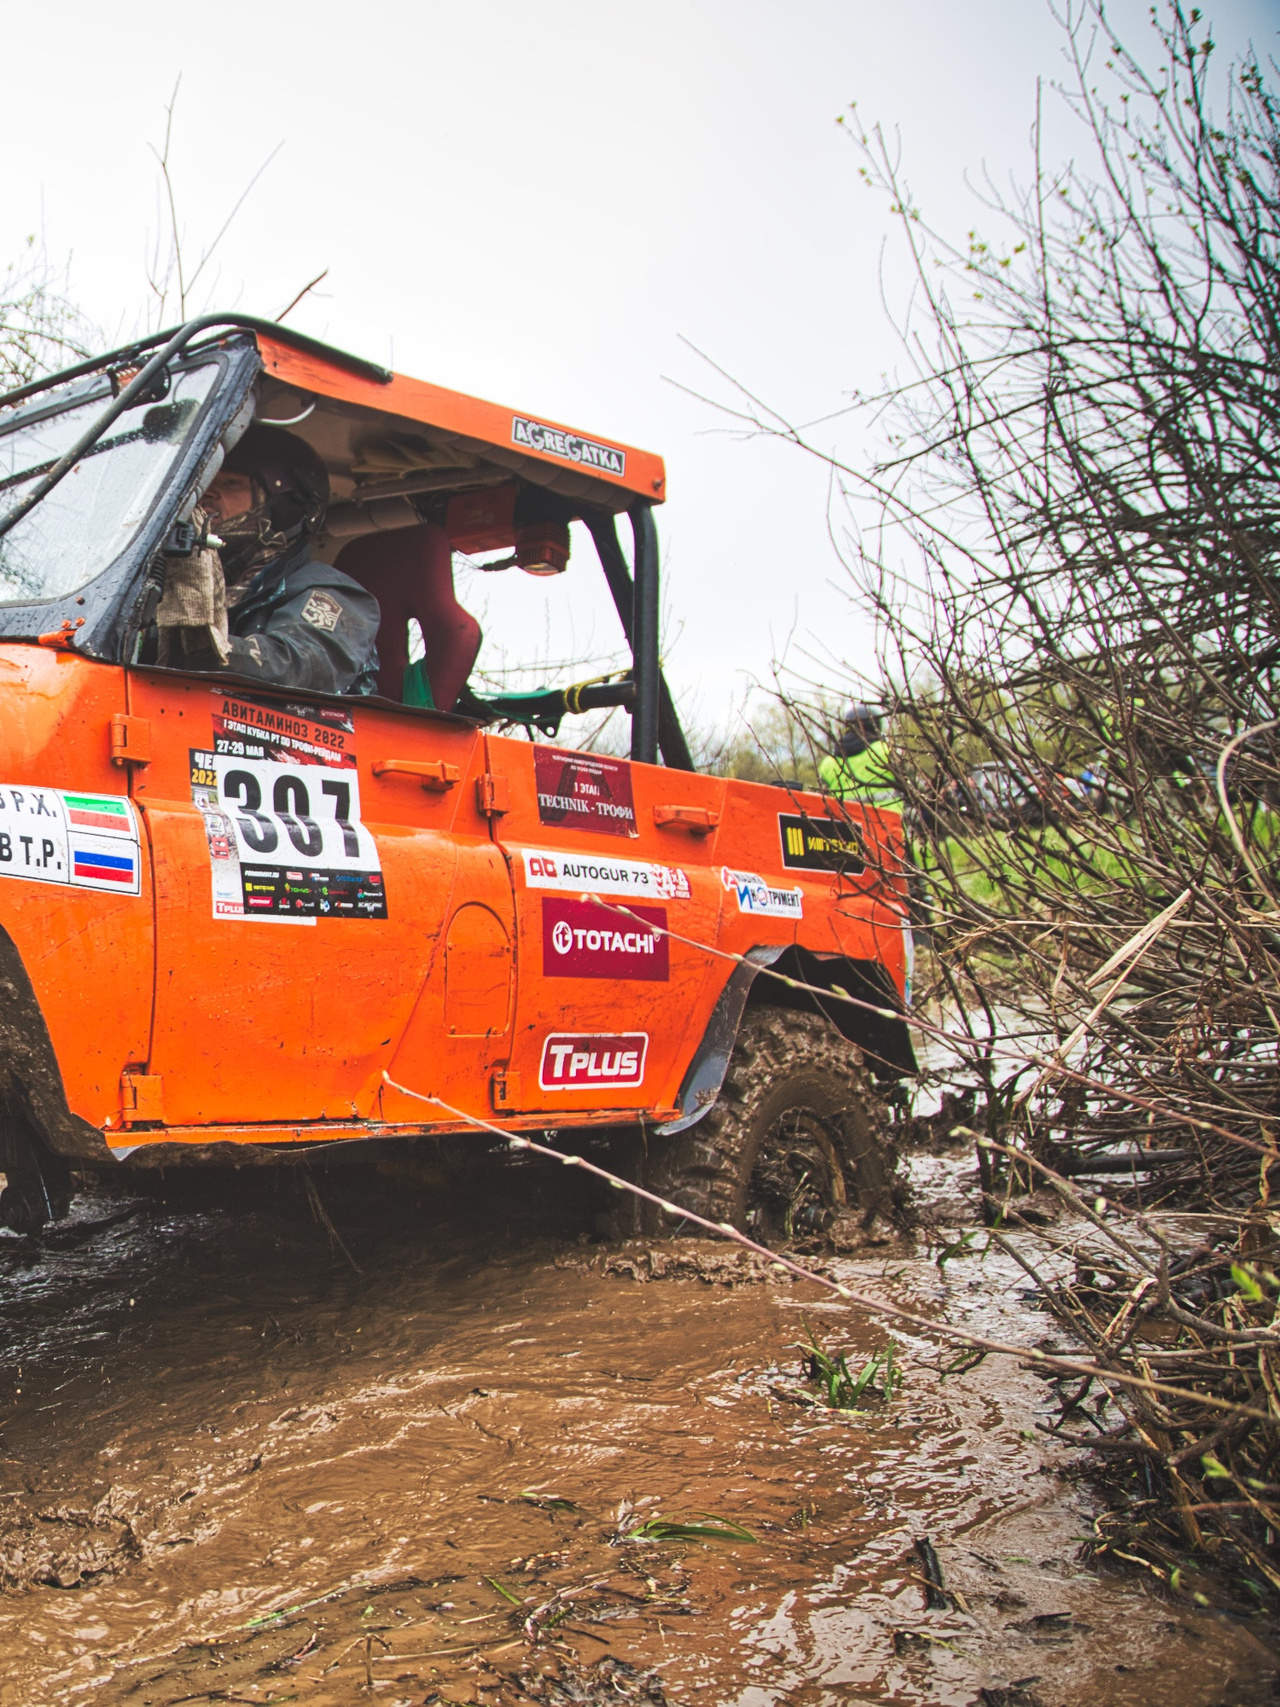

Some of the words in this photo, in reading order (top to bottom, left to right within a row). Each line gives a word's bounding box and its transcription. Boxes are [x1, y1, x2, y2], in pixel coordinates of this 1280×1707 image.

[516, 421, 621, 472] AGREGATKA
[222, 700, 308, 738] АВИТАМИНОЗ
[314, 728, 345, 749] 2022
[228, 720, 247, 734] ЭТАП
[247, 725, 270, 741] КУБКА
[271, 733, 280, 744] РТ
[217, 740, 245, 755] 27-29
[246, 744, 264, 757] МАЯ
[10, 791, 58, 818] Р.Х.
[224, 770, 360, 857] 307
[538, 793, 590, 813] TECHNIK
[596, 802, 633, 820] ТРОФИ
[20, 836, 62, 870] Т.Р.
[562, 864, 629, 882] AUTOGUR
[632, 871, 649, 884] 73
[573, 929, 655, 954] TOTACHI
[550, 1045, 638, 1078] TPLUS
